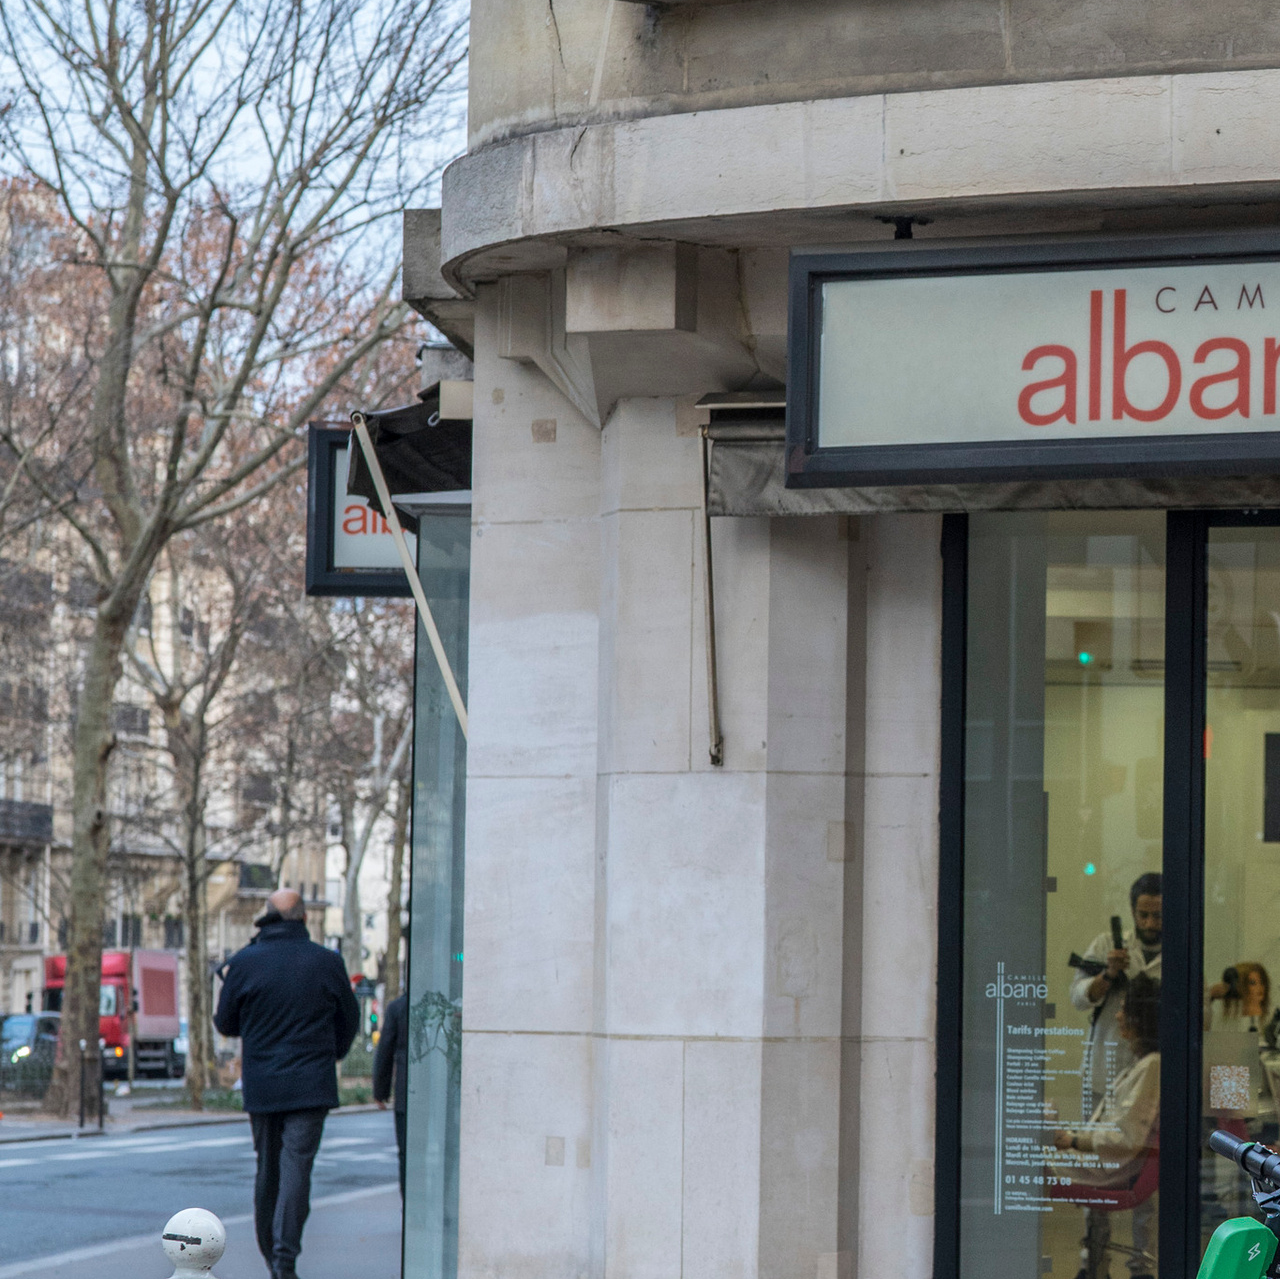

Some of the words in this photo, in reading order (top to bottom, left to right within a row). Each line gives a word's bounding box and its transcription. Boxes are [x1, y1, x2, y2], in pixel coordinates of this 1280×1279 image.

[1007, 974, 1047, 982] CAMILLE
[985, 975, 1048, 999] albane
[1007, 1025, 1032, 1035] Tarifs
[1034, 1026, 1085, 1038] prestations
[1005, 1175, 1016, 1184] 01
[1019, 1175, 1031, 1185] 45
[1032, 1176, 1045, 1185] 48
[1047, 1176, 1058, 1186] 73
[1060, 1177, 1072, 1187] 08
